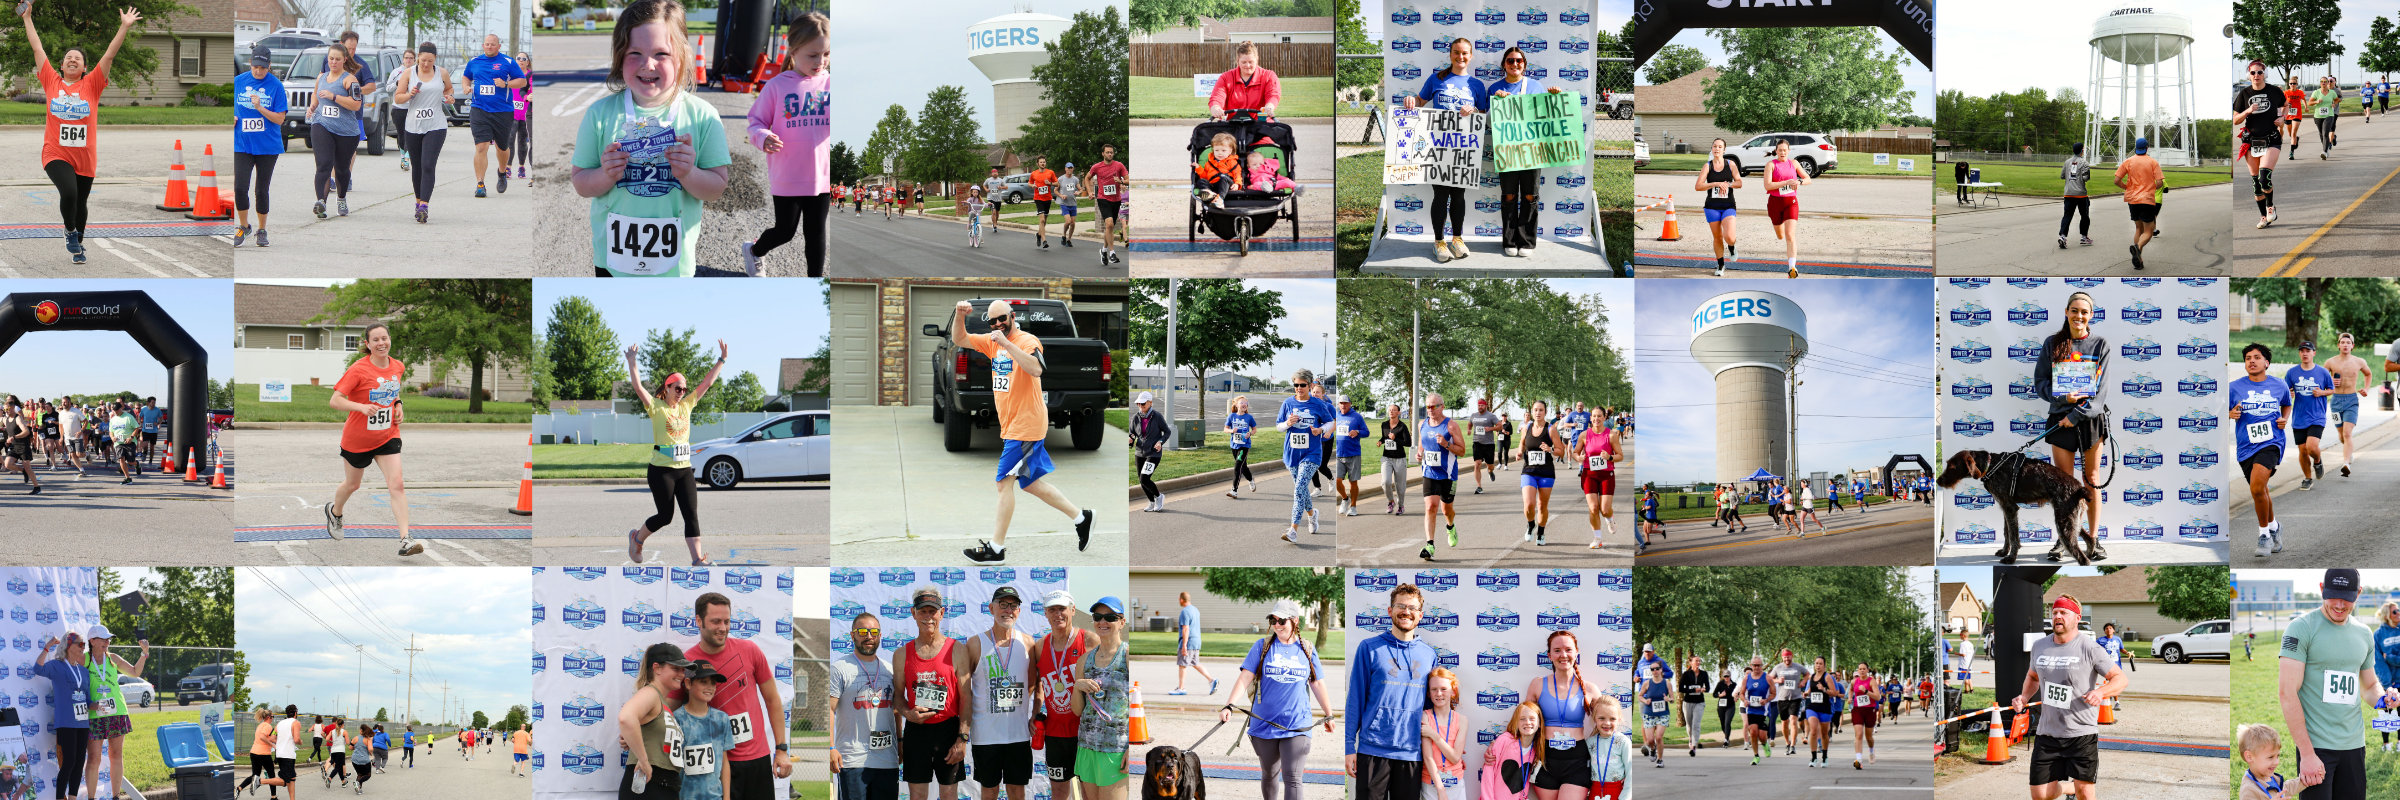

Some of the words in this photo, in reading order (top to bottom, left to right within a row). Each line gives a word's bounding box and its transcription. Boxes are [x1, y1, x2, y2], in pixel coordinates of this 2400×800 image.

[2110, 7, 2154, 17] CARTHAGE
[970, 27, 1040, 50] TIGERS
[480, 86, 495, 94] 211
[784, 91, 830, 118] GAP
[1453, 96, 1461, 104] 2
[65, 104, 73, 113] 2
[323, 108, 339, 117] 113
[1491, 96, 1524, 122] RUN
[1533, 93, 1574, 120] LIKE
[416, 109, 433, 118] 200
[243, 119, 264, 130] 109
[786, 118, 830, 128] ORIGINAL
[1421, 110, 1463, 132] THERE
[1470, 113, 1483, 133] IS
[61, 126, 85, 141] 564
[1493, 121, 1523, 144] YOU
[1525, 119, 1571, 140] STOLE
[641, 138, 652, 149] 2
[652, 133, 674, 144] TOWER
[1430, 132, 1479, 148] WATER
[1424, 147, 1447, 162] AT
[1452, 148, 1476, 167] THE
[1494, 139, 1580, 171] SOMETHING!!!
[622, 169, 642, 180] OWER
[644, 165, 657, 182] 2
[659, 169, 675, 180] TOW
[1420, 164, 1479, 187] TOWER!!
[611, 220, 678, 258] 1429
[63, 304, 120, 316] runaround
[1693, 298, 1772, 334] TIGERS
[1968, 312, 1975, 320] 2
[2025, 312, 2032, 320] 2
[994, 377, 1009, 390] 132
[386, 390, 393, 399] 2
[1969, 387, 1976, 395] 2
[2257, 402, 2264, 410] 2
[369, 409, 390, 425] 551
[2250, 423, 2269, 438] 549
[1292, 434, 1306, 445] 515
[1426, 453, 1438, 462] 574
[1530, 452, 1543, 461] 579
[640, 566, 647, 576] 2
[687, 571, 694, 582] 2
[1373, 577, 1380, 585] 2
[1494, 576, 1502, 585] 2
[1555, 576, 1562, 585] 2
[581, 611, 588, 621] 2
[624, 614, 639, 622] TOWER
[639, 613, 646, 624] 2
[1495, 617, 1502, 625] 2
[1555, 617, 1562, 625] 2
[1282, 667, 1290, 676] 2
[2329, 674, 2355, 696] 540
[916, 687, 945, 702] 5736
[999, 688, 1023, 699] 5634
[2048, 684, 2068, 702] 555
[580, 708, 587, 718] 2
[587, 709, 604, 717] TOWER
[2386, 719, 2392, 728] 2
[871, 735, 892, 747] 5734
[685, 746, 714, 767] 579
